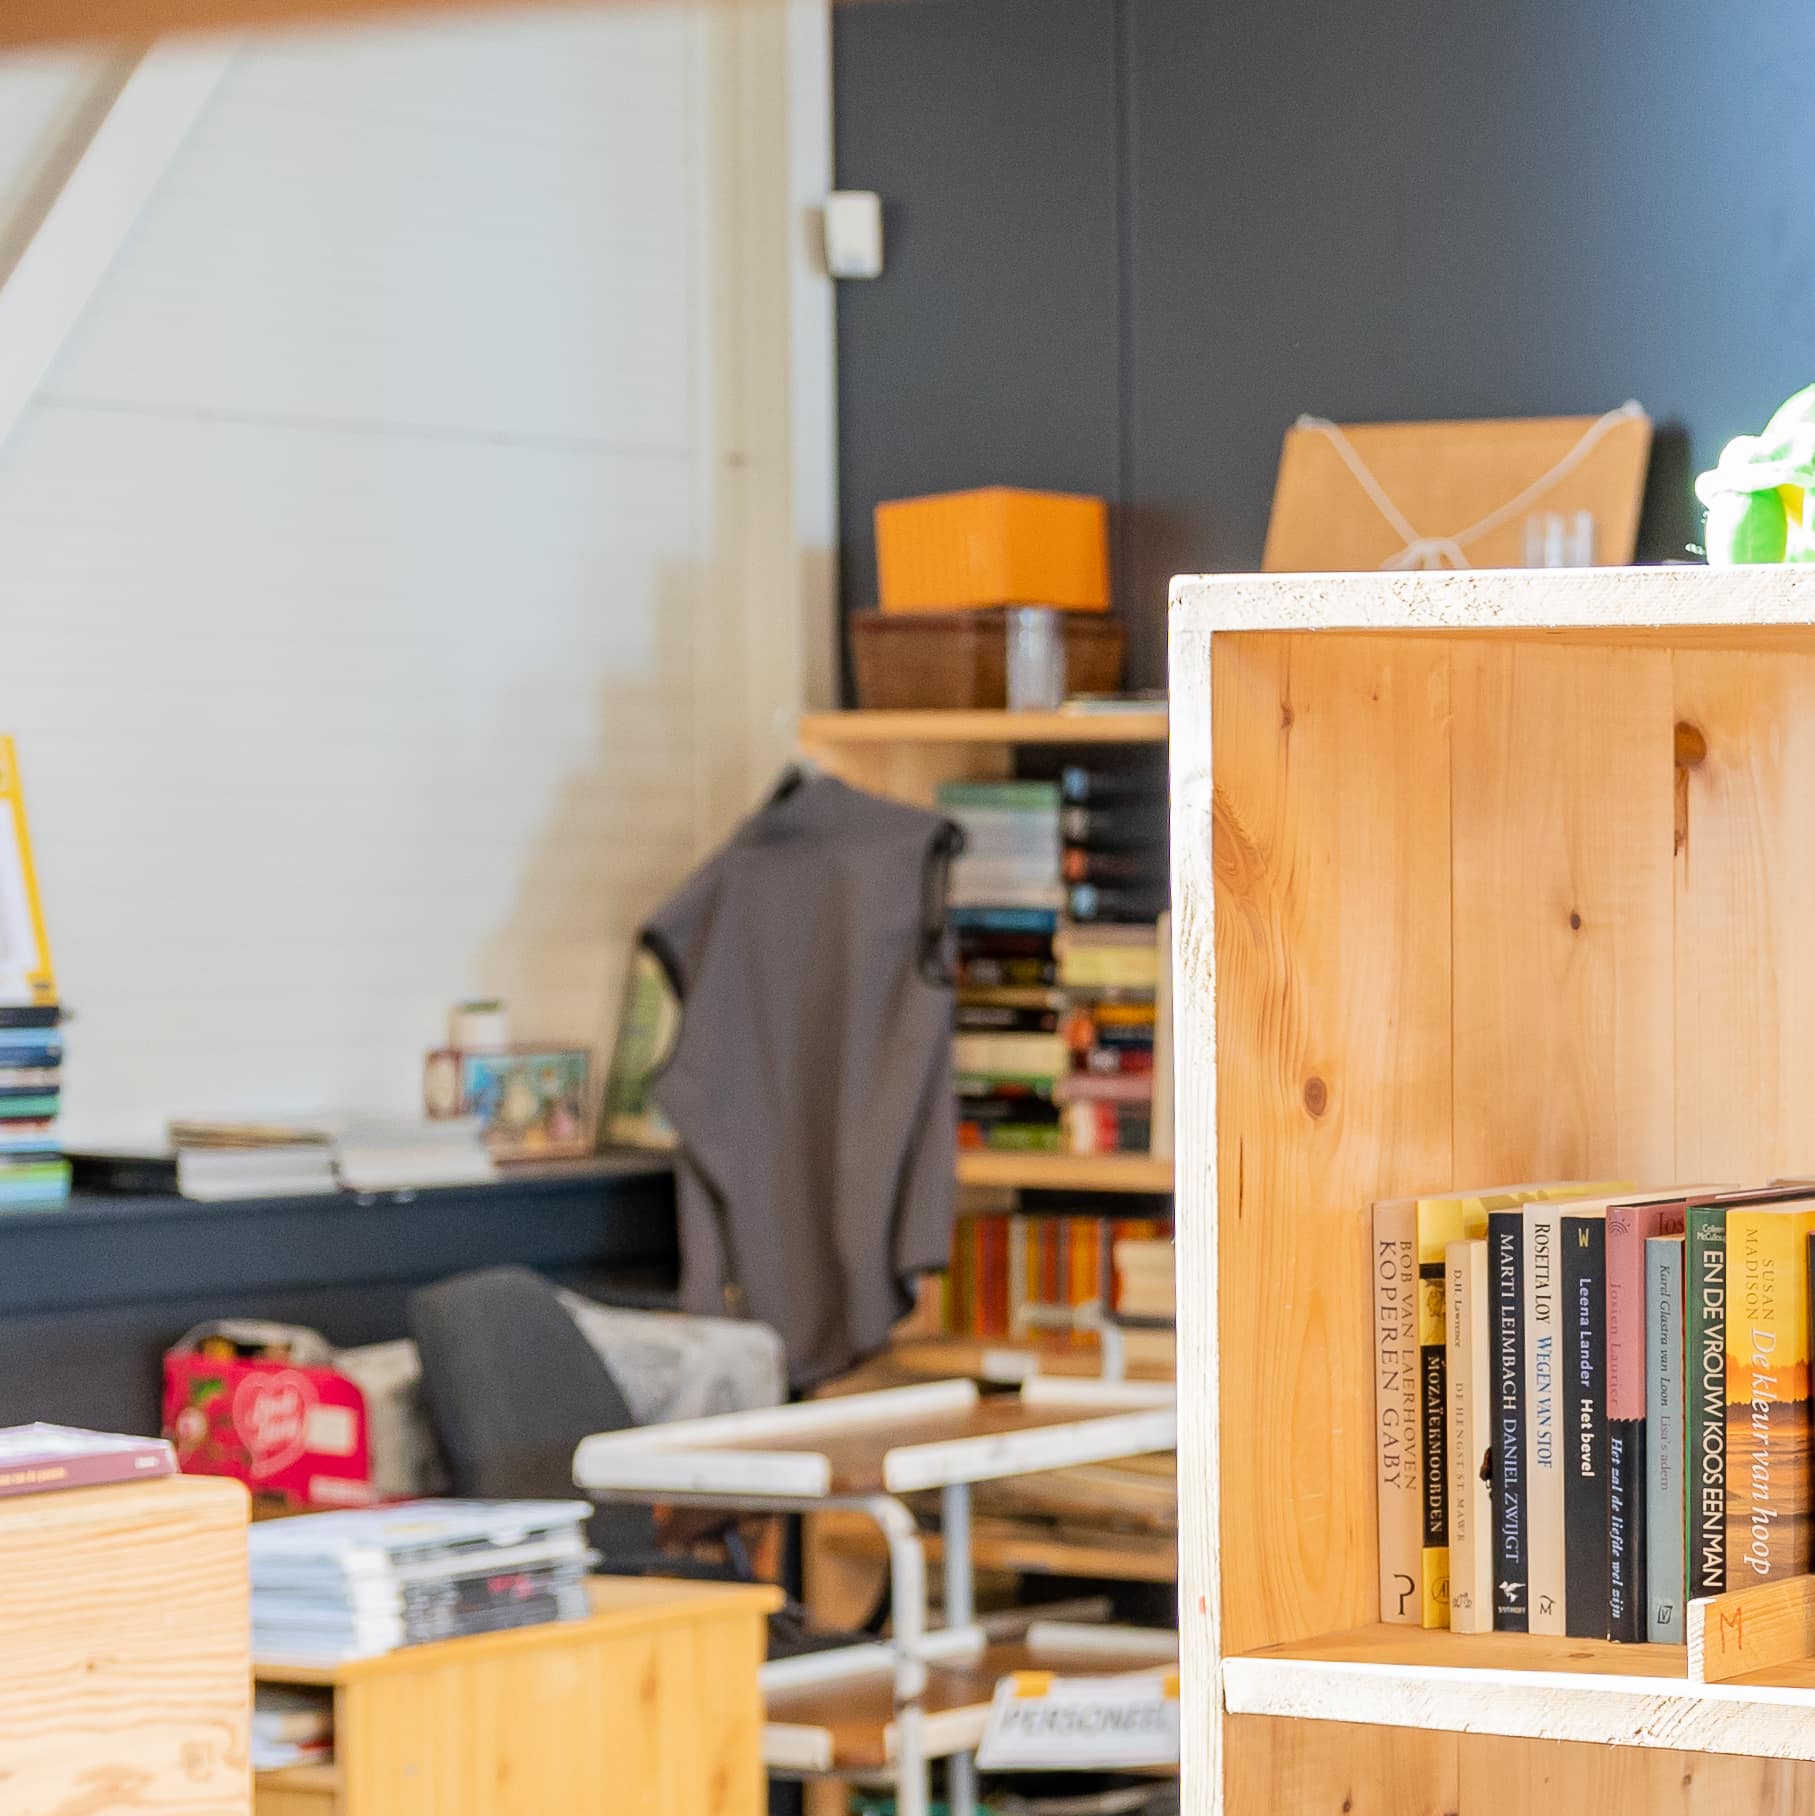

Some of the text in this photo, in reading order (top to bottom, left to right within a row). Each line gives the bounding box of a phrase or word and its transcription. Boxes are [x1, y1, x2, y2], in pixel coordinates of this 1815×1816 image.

[1380, 1241, 1400, 1490] KOPEREN GABY
[1500, 1234, 1516, 1410] MARTI LEIMBACH
[1579, 1278, 1593, 1387] Leena Lander
[1502, 1418, 1518, 1564] DANIEL ZWIJGT
[1580, 1399, 1594, 1476] Het bevel
[1702, 1251, 1723, 1587] EN DE VROUW KOOS EEN MAN
[1744, 1328, 1777, 1575] De kleur van hoop
